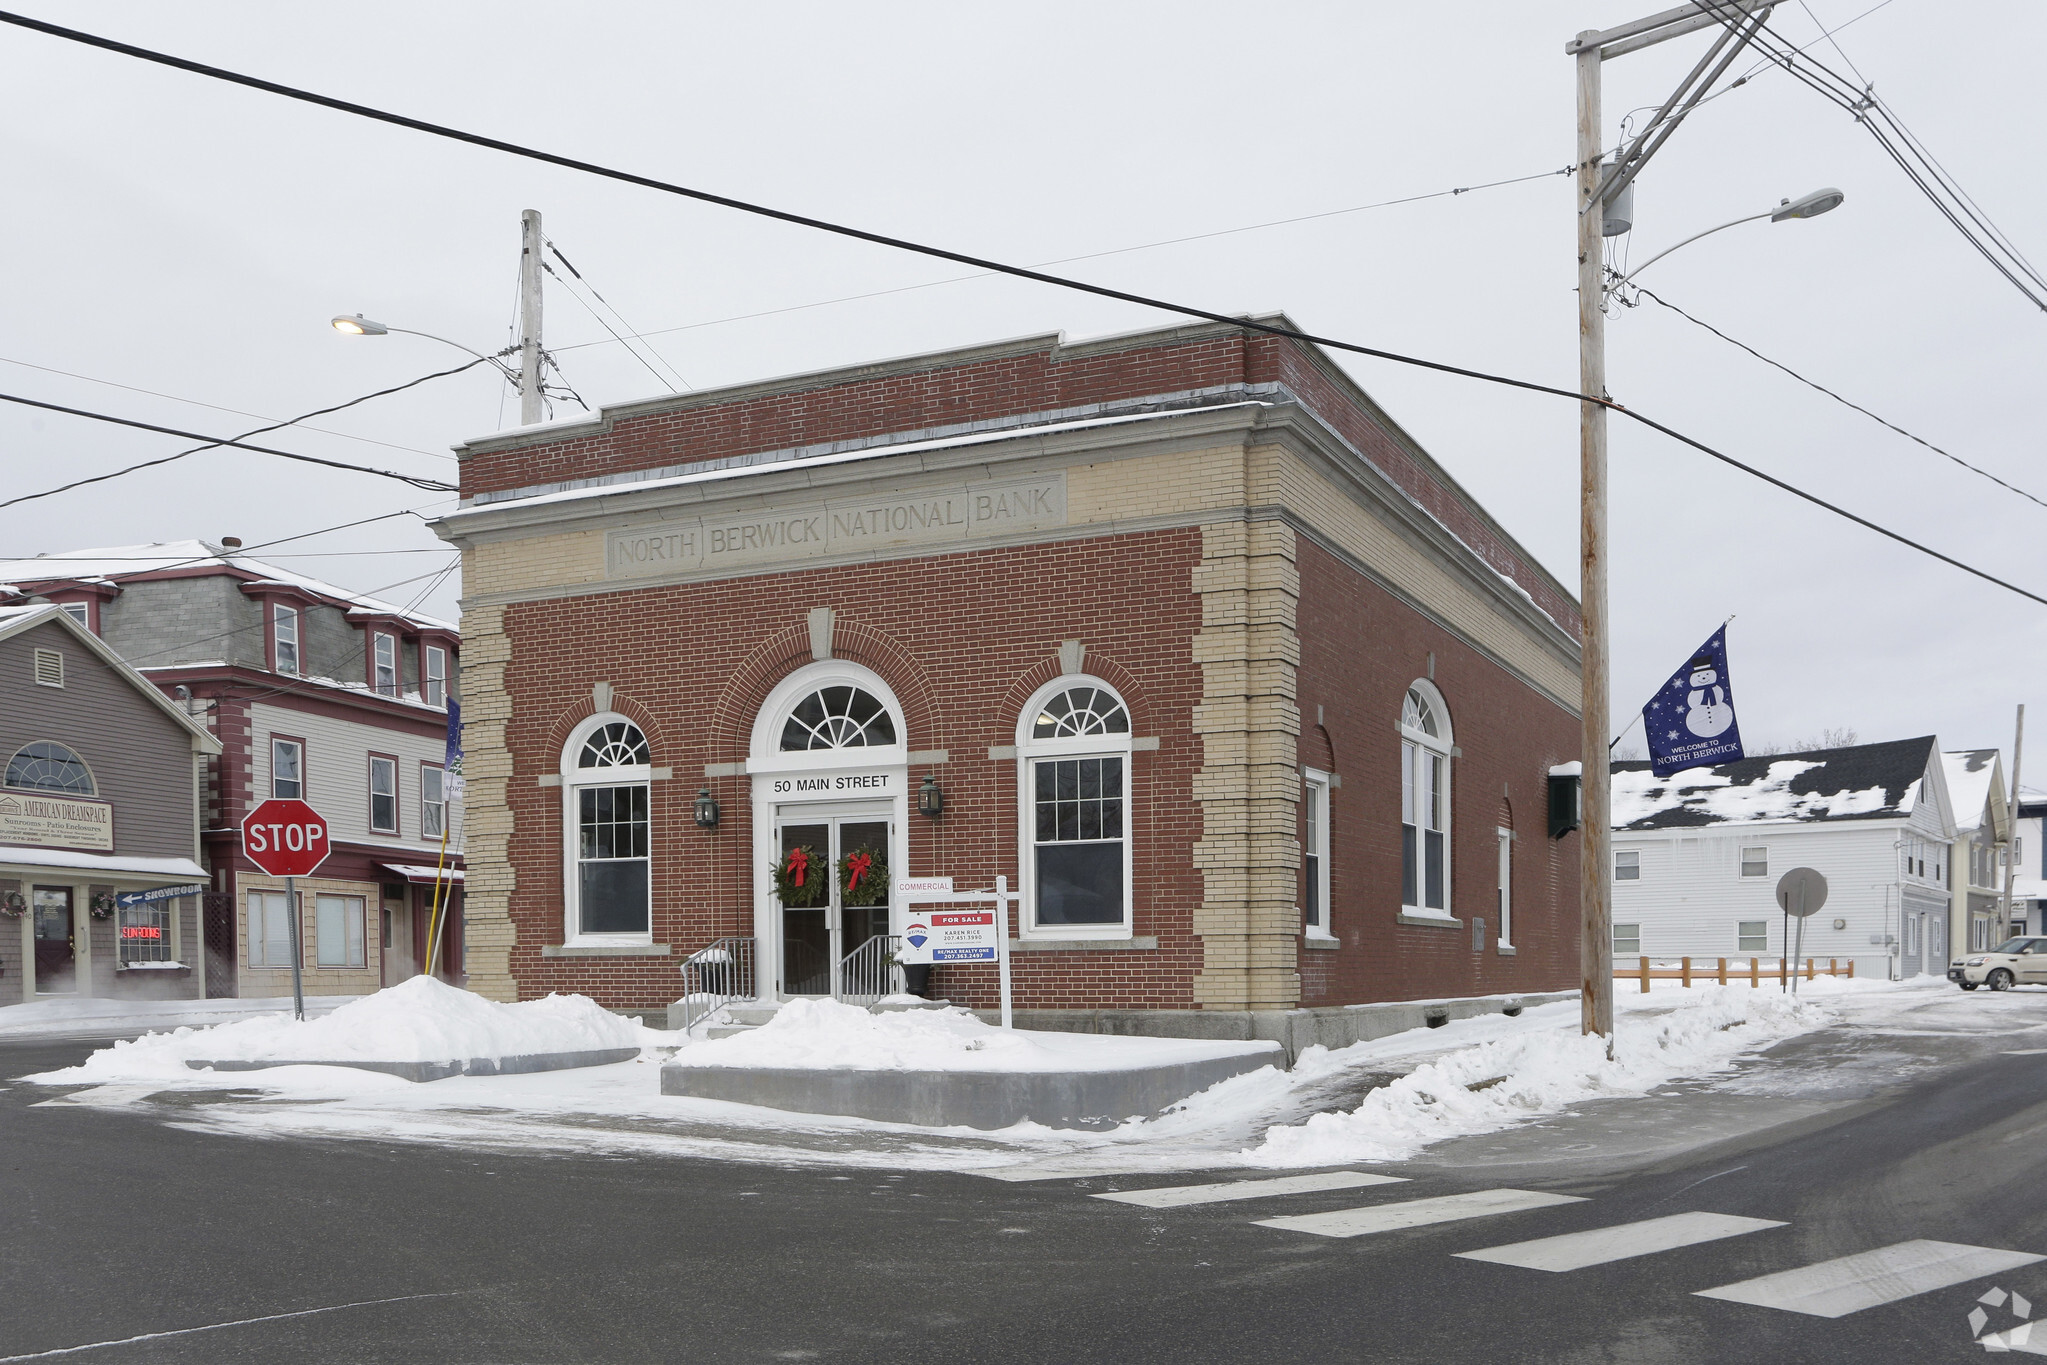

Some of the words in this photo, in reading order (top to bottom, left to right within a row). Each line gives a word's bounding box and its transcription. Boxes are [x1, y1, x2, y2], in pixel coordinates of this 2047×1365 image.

[618, 532, 696, 565] NORTH
[711, 516, 821, 554] BERWICK
[833, 500, 964, 539] NATIONAL
[976, 487, 1053, 521] BANK
[1657, 752, 1691, 766] NORTH
[1693, 743, 1738, 759] BERWICK
[1671, 741, 1708, 754] WELCOME
[1709, 739, 1719, 747] TO
[774, 780, 791, 793] 50
[797, 778, 830, 791] MAIN
[836, 775, 889, 790] STREET
[23, 800, 61, 820] AMERICAN
[62, 804, 107, 824] DREAMSPACE
[4, 817, 42, 827] Sunrooms
[46, 821, 65, 830] Patio
[65, 822, 102, 832] Enclosures
[249, 823, 324, 853] STOP
[144, 884, 202, 901] SHOWROOM
[899, 883, 949, 891] COMMERCIAL
